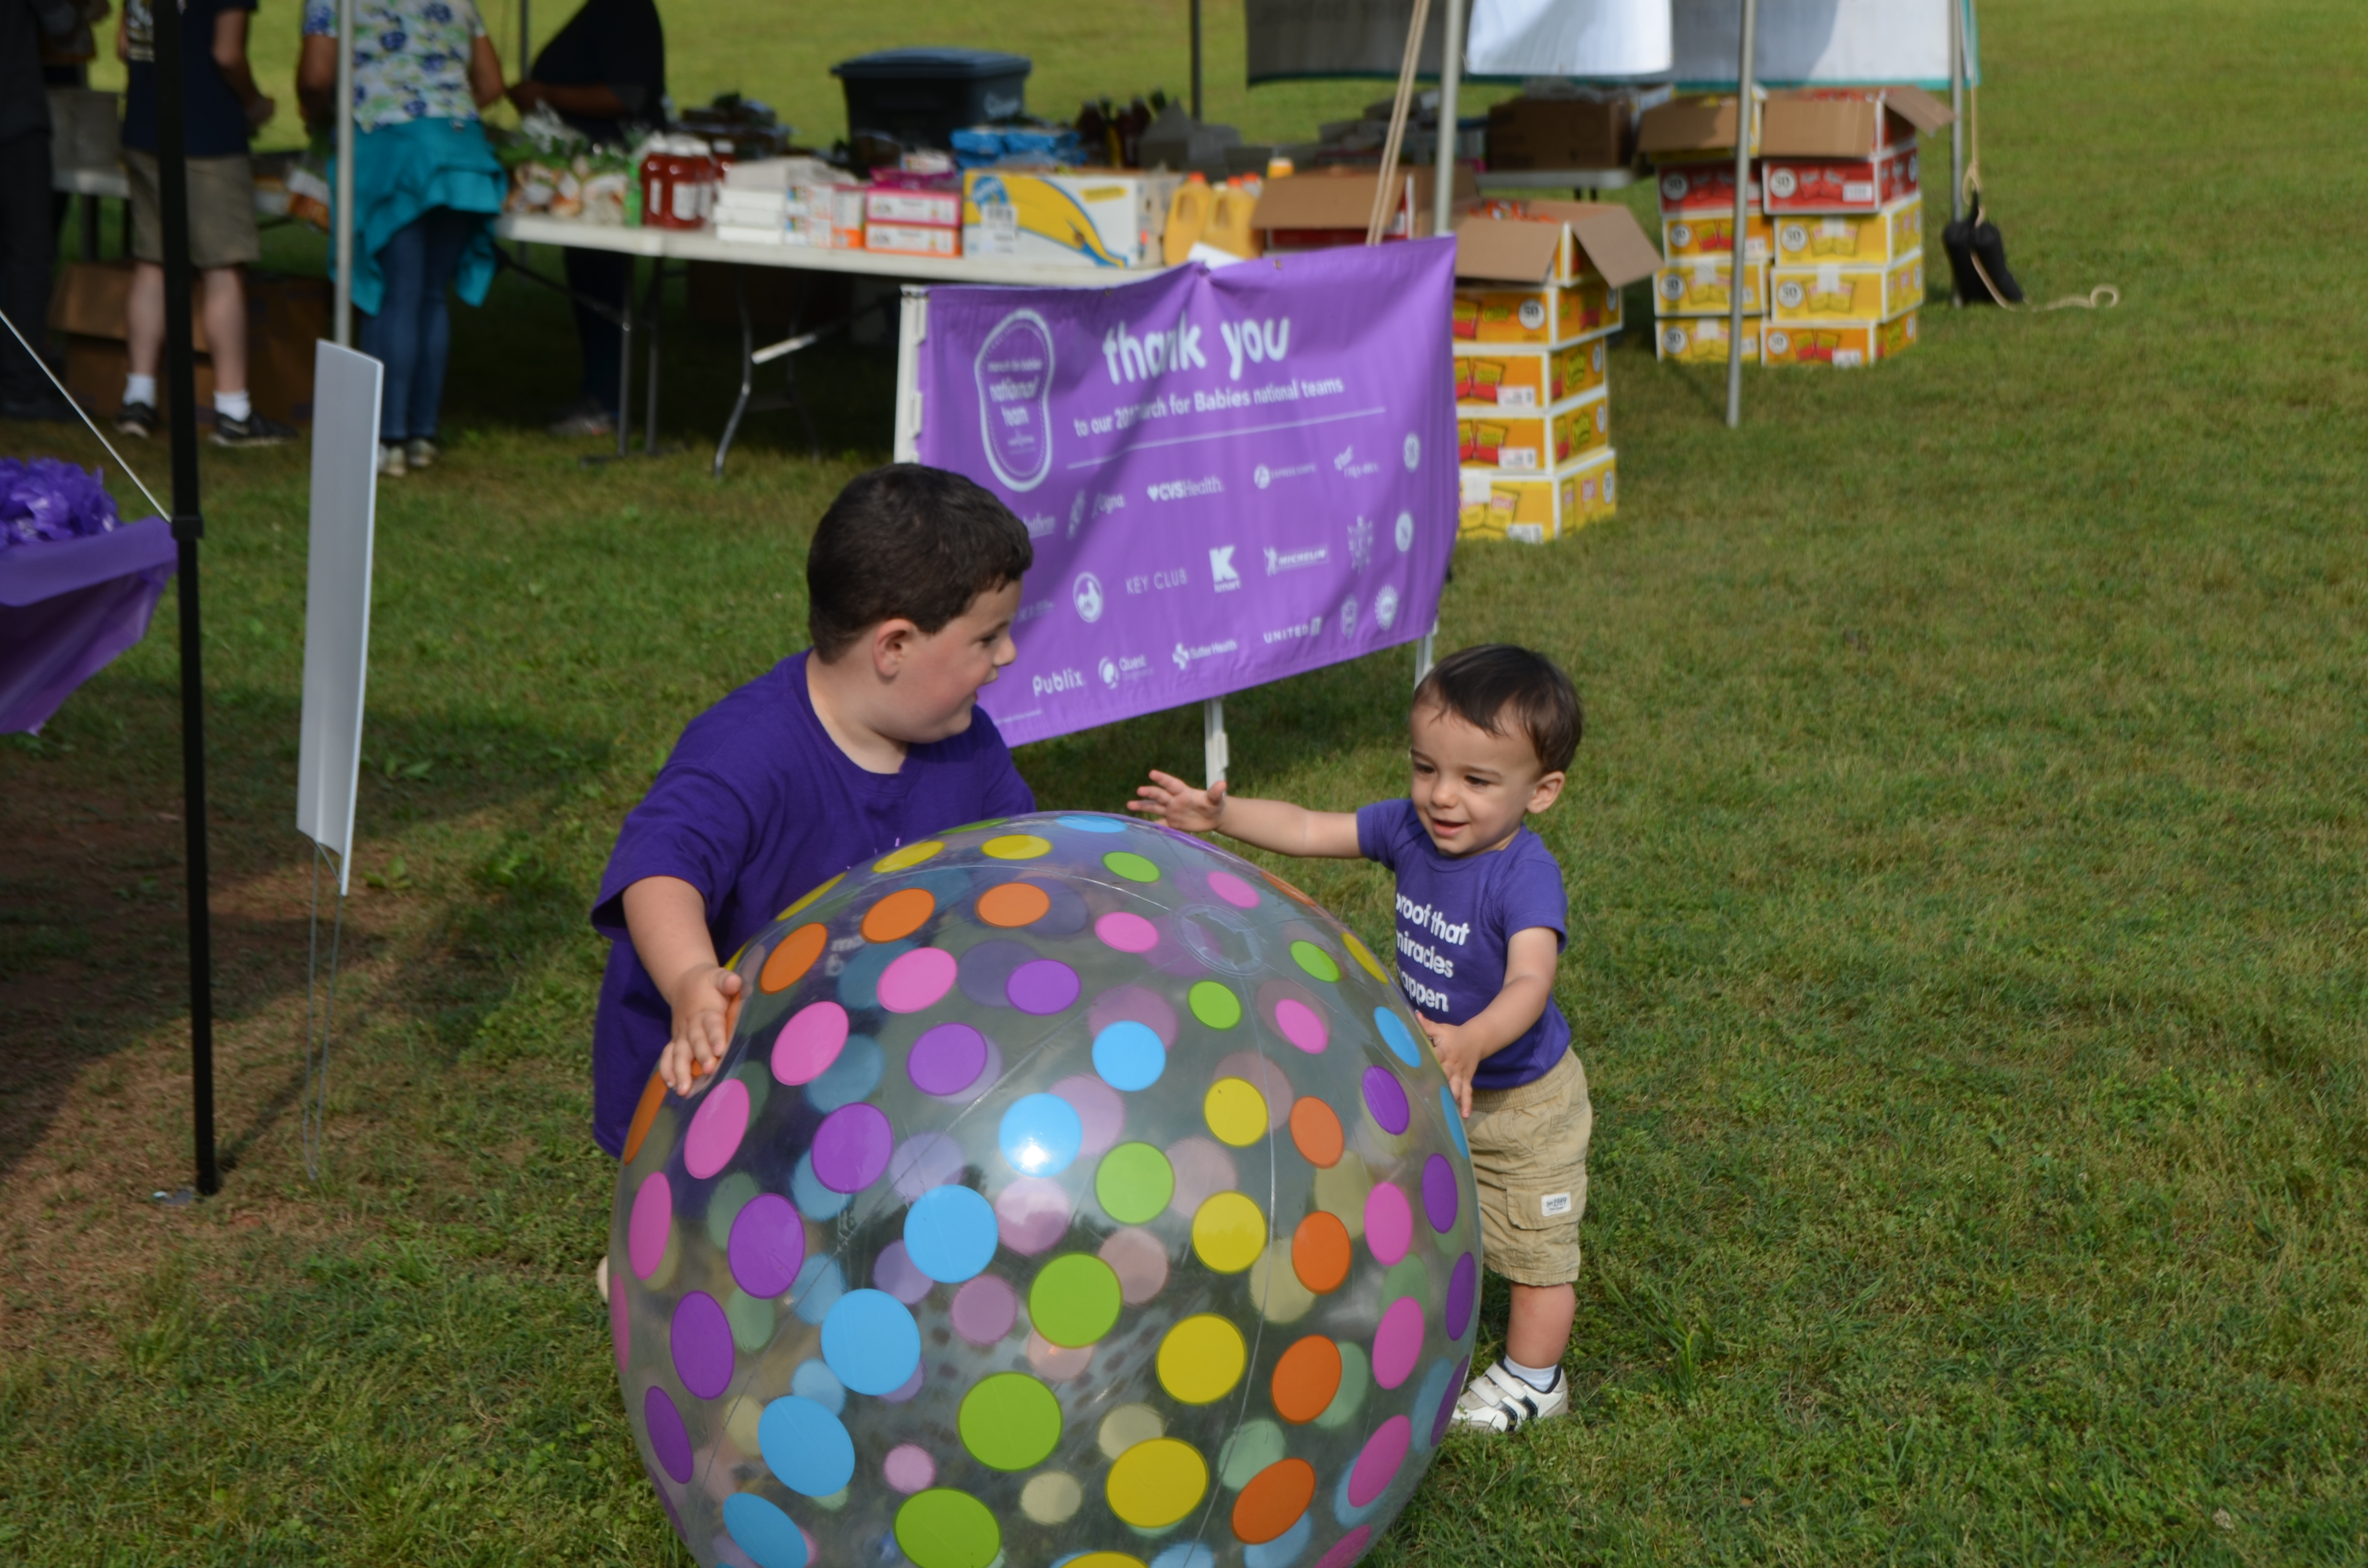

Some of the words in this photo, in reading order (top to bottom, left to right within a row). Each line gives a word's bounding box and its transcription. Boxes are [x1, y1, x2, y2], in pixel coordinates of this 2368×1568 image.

[1776, 175, 1789, 188] 50
[1787, 230, 1801, 241] 50
[1782, 287, 1797, 296] 50
[1523, 304, 1538, 314] 50
[1220, 316, 1290, 381] you
[989, 375, 1039, 402] national
[1074, 418, 1089, 437] to
[1091, 416, 1113, 433] our
[1170, 393, 1190, 416] for
[1194, 387, 1251, 412] Babies
[1253, 378, 1298, 404] national
[1301, 377, 1344, 398] teams
[1000, 406, 1029, 427] team
[1125, 575, 1149, 595] KEY
[1153, 567, 1188, 589] CLUB
[1263, 625, 1309, 644] UNITED
[1212, 639, 1237, 654] Health
[1119, 654, 1146, 672] Quest
[1431, 911, 1470, 945] that
[1554, 1197, 1566, 1206] 1989
